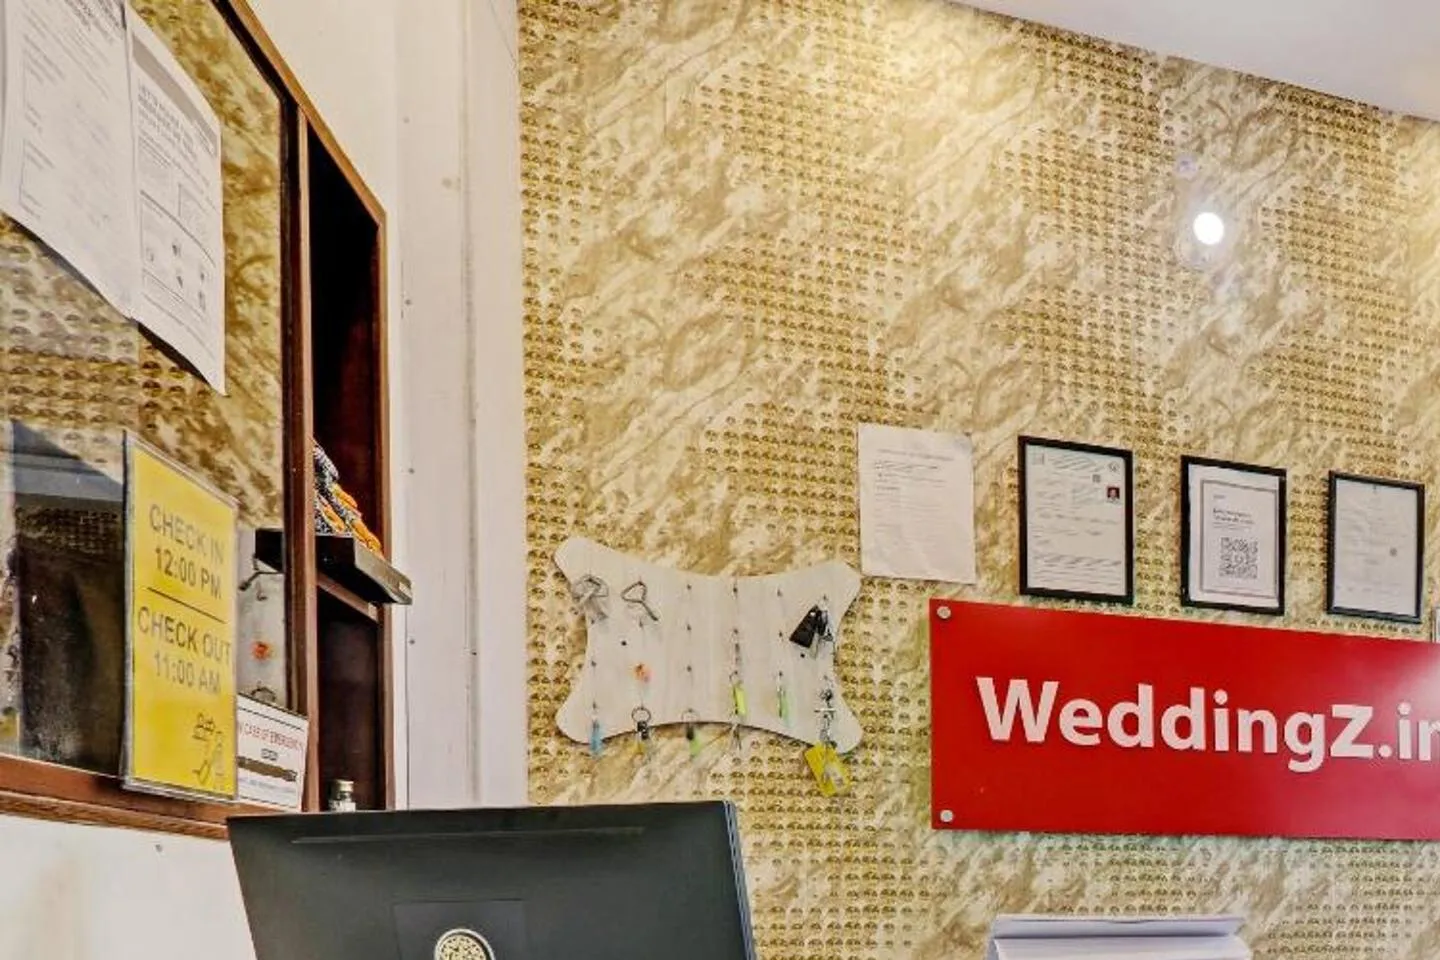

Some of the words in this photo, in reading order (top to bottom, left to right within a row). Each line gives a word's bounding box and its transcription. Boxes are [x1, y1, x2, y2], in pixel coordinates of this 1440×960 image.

[149, 504, 208, 557] CHECK
[210, 539, 225, 564] IN
[155, 547, 196, 587] 12:00
[200, 567, 222, 599] PM
[138, 606, 198, 652] CHECK
[202, 634, 231, 666] OUT
[154, 651, 195, 688] 11:00
[199, 665, 221, 693] AM
